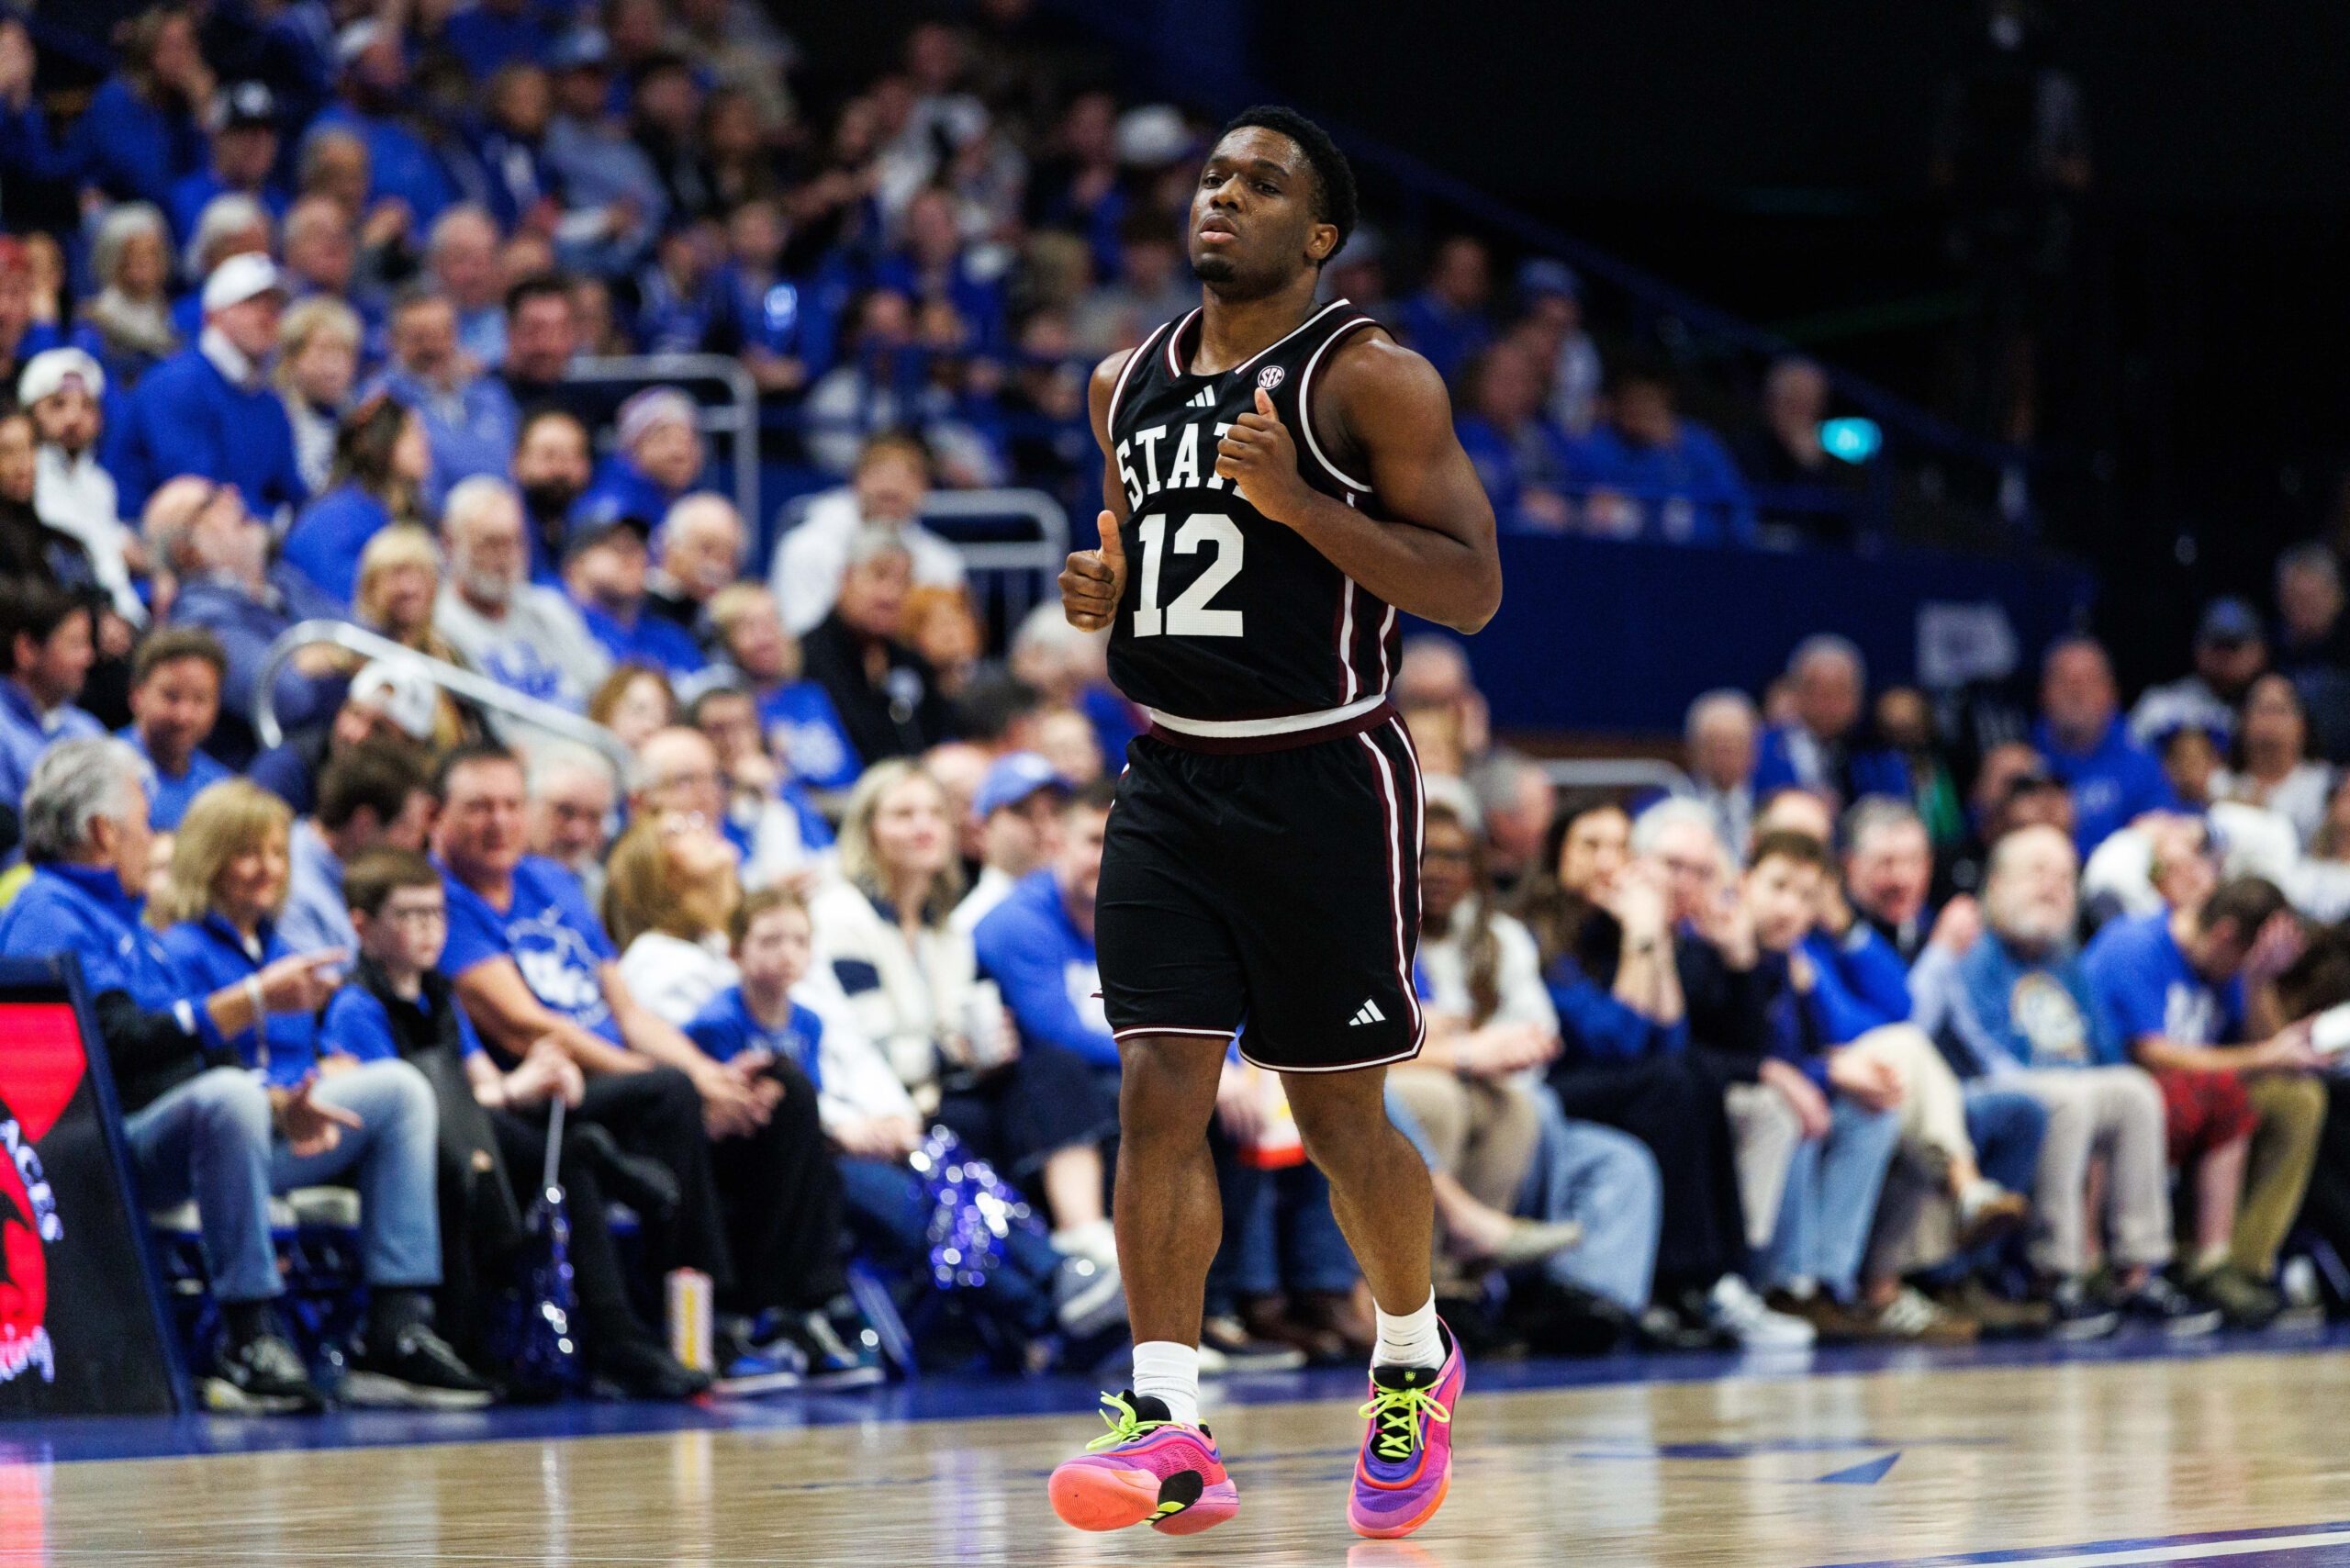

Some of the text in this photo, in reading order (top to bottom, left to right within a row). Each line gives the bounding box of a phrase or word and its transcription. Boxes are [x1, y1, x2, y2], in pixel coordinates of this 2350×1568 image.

[1259, 367, 1282, 387] SEC
[1116, 422, 1249, 511] STA
[1134, 513, 1244, 637] 12
